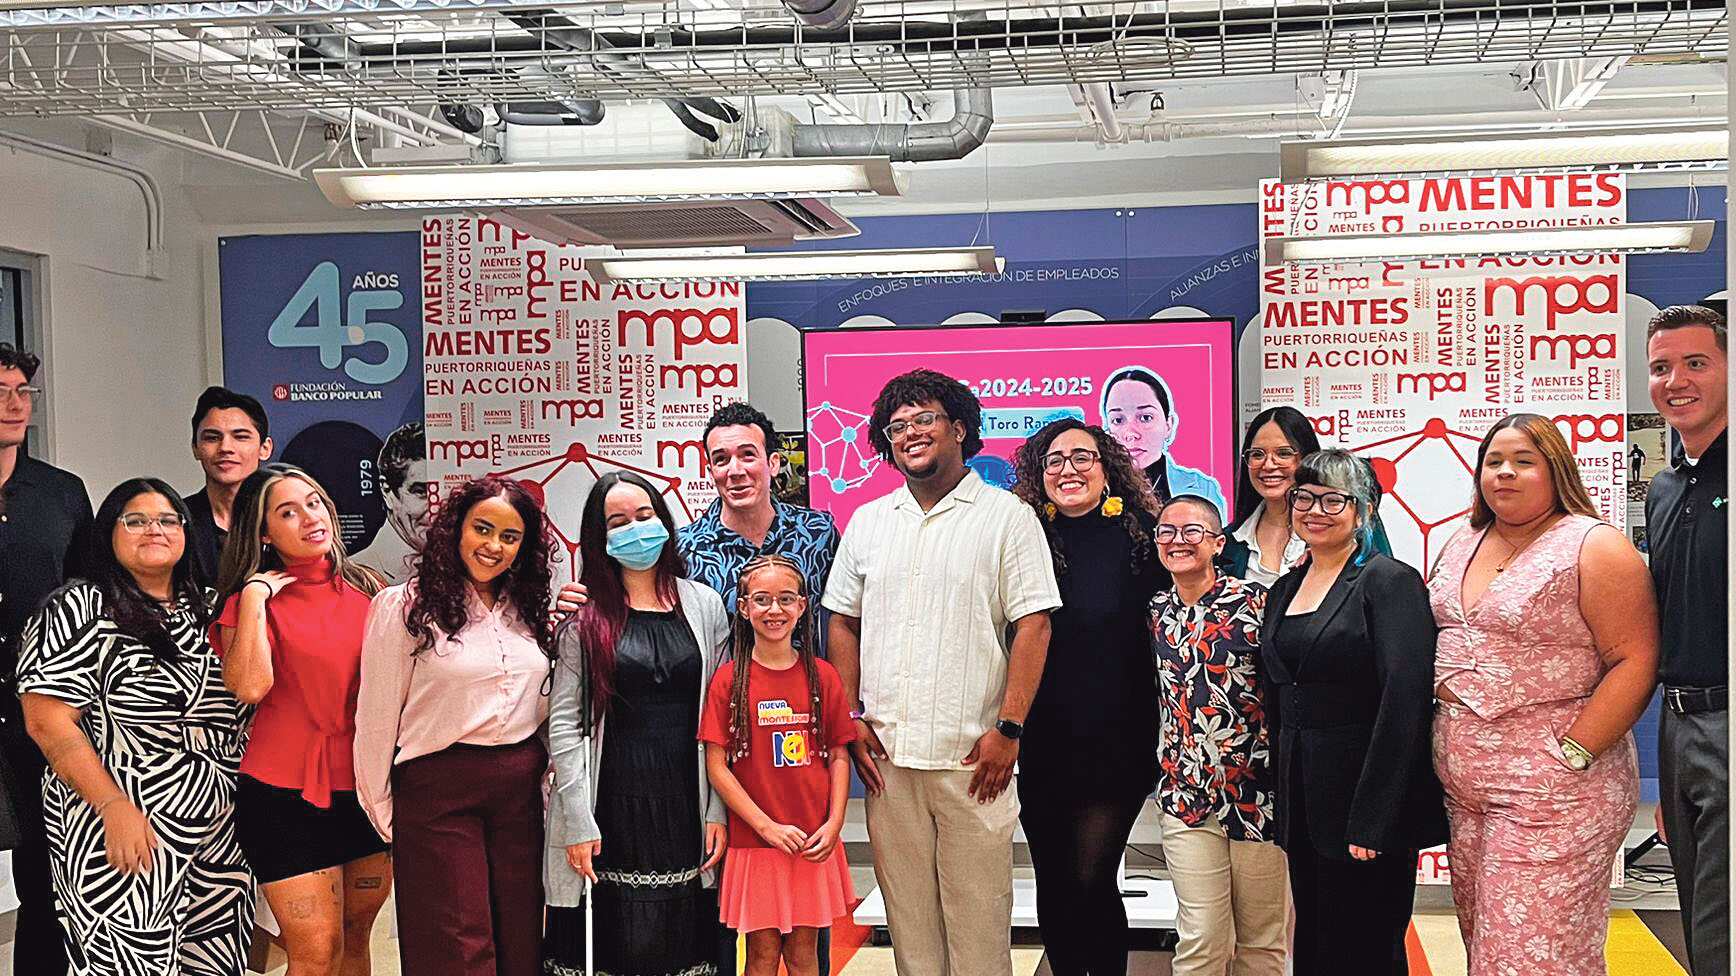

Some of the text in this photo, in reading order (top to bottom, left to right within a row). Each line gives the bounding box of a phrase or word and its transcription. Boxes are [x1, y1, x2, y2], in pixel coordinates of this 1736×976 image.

[1326, 180, 1409, 215] mpa
[1418, 174, 1622, 212] MENTES
[1328, 223, 1375, 233] MENTES
[1333, 211, 1357, 220] mpa
[480, 258, 521, 267] MENTES
[484, 246, 506, 256] mpa
[352, 272, 399, 288] AÑOS
[422, 218, 442, 326] MENTES
[456, 218, 472, 324] EN ACCIÓN
[492, 272, 521, 280] ACCIÓN
[527, 250, 554, 318] mpa
[1170, 260, 1230, 301] ALIANZAS
[1231, 256, 1241, 268] E
[1305, 267, 1318, 294] EN
[494, 286, 523, 299] mpa
[560, 280, 600, 302] EN
[838, 279, 908, 313] ENFOQUES
[1016, 270, 1034, 281] DE
[1038, 268, 1119, 280] EMPLEADOS
[1329, 277, 1370, 294] mpa
[1264, 298, 1408, 328] MENTES
[1485, 274, 1618, 330] mpa
[268, 262, 408, 384] 45
[480, 308, 516, 325] mpa
[1438, 288, 1452, 367] MENTES
[1464, 288, 1476, 365] EN ACCIÓN
[425, 328, 552, 356] MENTES
[618, 308, 738, 360] mpa
[1264, 330, 1407, 346] PUERTORRIQUEÑAS
[576, 318, 590, 394] MENTES
[600, 319, 612, 394] EN ACCIÓN
[1264, 345, 1407, 369] EN ACCIÓN
[1485, 324, 1500, 404] MENTES
[1512, 324, 1524, 403] EN ACCIÓN
[1530, 334, 1616, 369] mpa
[426, 360, 550, 374] PUERTORRIQUEÑAS
[291, 381, 346, 392] FUNDACIÓN
[426, 380, 454, 395] EN
[462, 373, 551, 394] ACCIÓN
[619, 354, 634, 430] MENTES
[645, 354, 656, 429] EN ACCIÓN
[660, 364, 738, 398] mpa
[980, 377, 1092, 397] 2024-2025
[1397, 372, 1466, 400] mpa
[1532, 377, 1584, 386] MENTES
[1588, 367, 1602, 400] mpa
[291, 390, 382, 400] BANCO POPULAR
[542, 399, 603, 426] mpa
[662, 404, 709, 414] MENTES
[1357, 409, 1406, 418] MENTES
[1459, 408, 1508, 418] MENTES
[989, 417, 1019, 430] Toro
[1339, 410, 1353, 442] mpa
[1372, 424, 1406, 432] ACCIÓN
[492, 434, 504, 466] mpa
[507, 434, 550, 443] MENTES
[598, 434, 641, 443] MENTES
[430, 440, 488, 467] mpa
[1578, 457, 1609, 467] NTES
[360, 460, 373, 497] 1979
[1612, 452, 1627, 485] mpa
